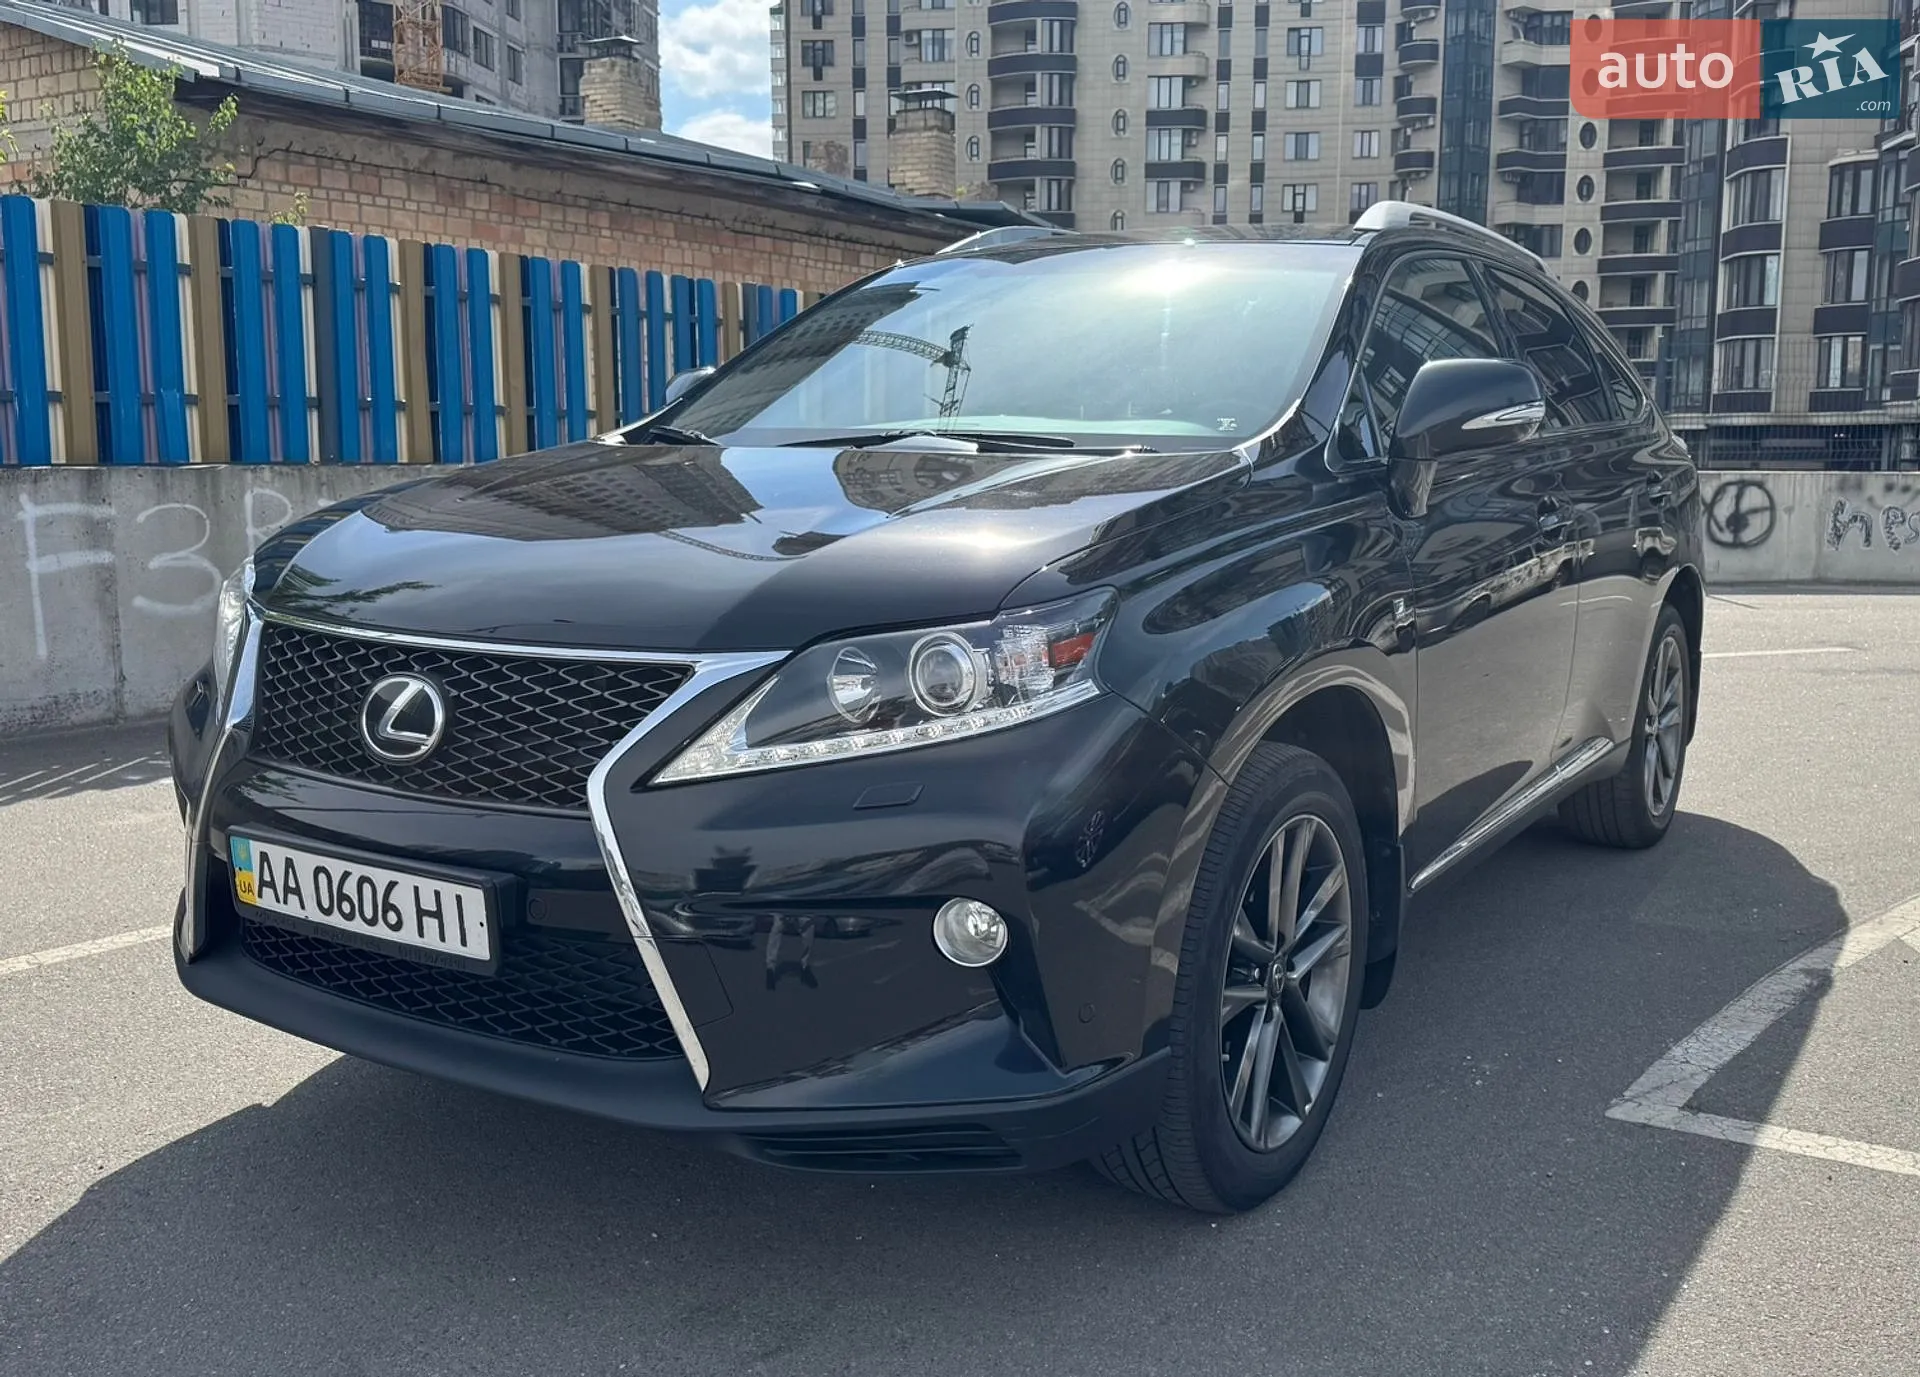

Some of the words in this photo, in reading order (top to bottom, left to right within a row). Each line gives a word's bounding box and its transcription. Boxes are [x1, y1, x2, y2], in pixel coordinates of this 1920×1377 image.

[240, 880, 255, 897] UA
[257, 851, 306, 911] AA
[313, 865, 403, 932] 0606
